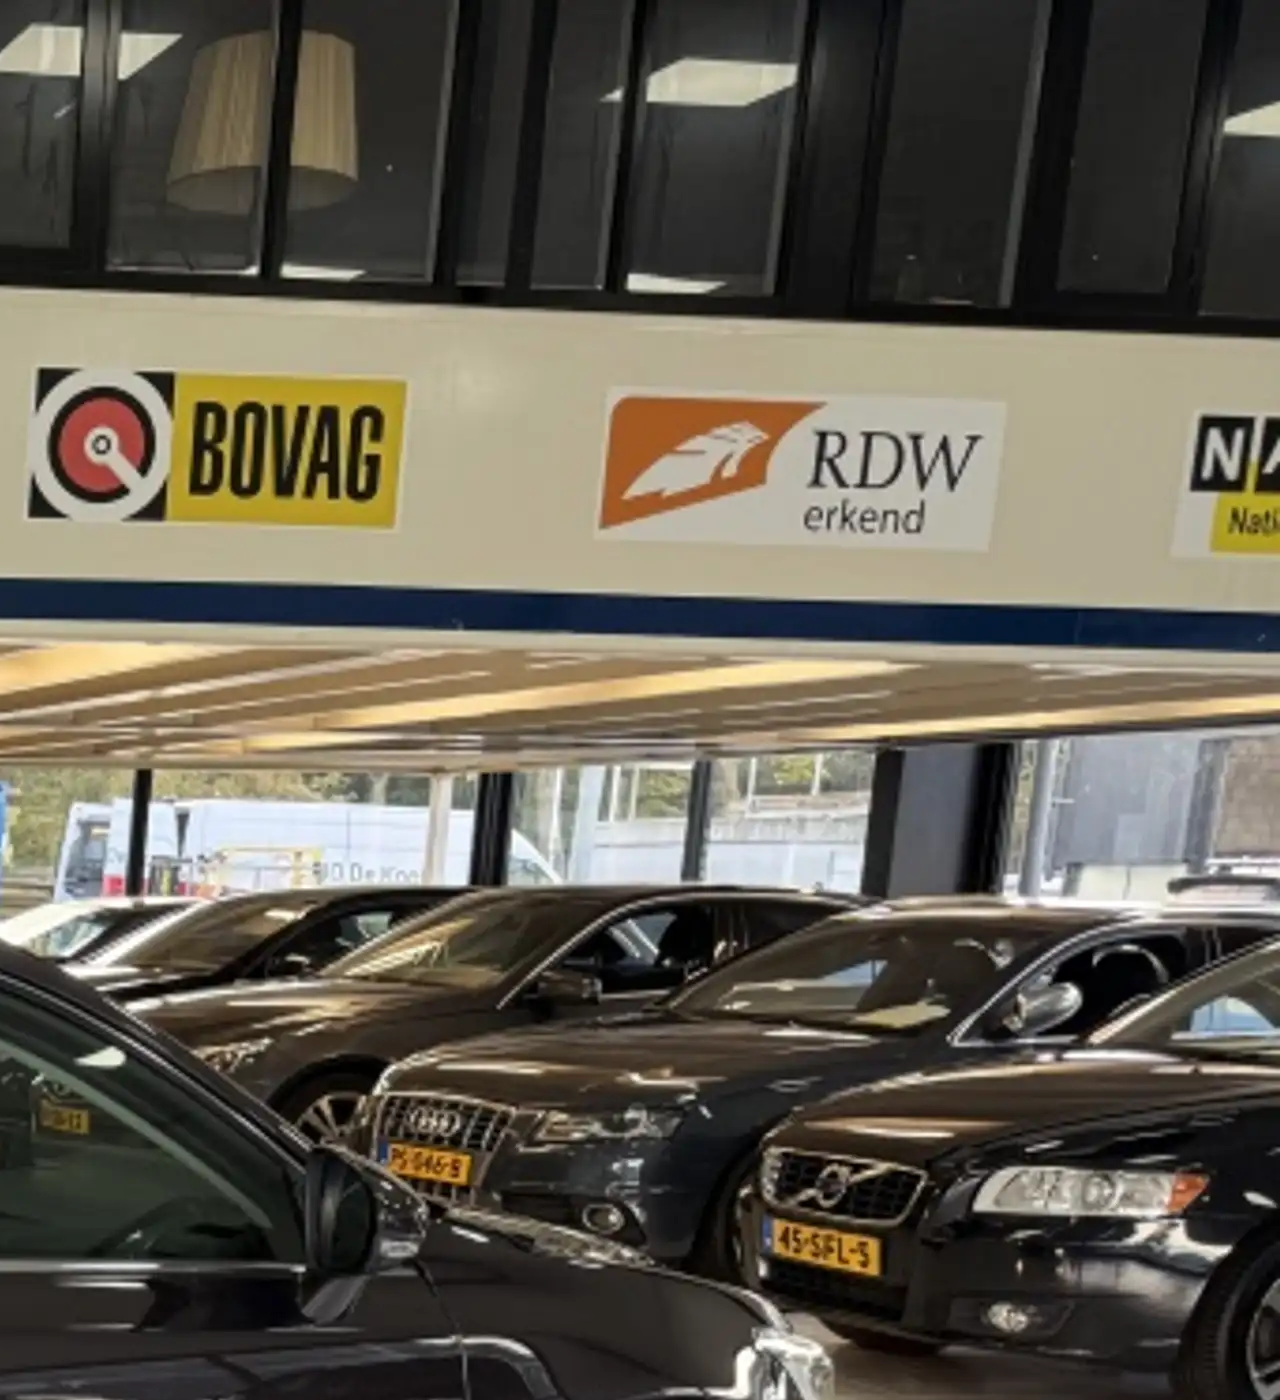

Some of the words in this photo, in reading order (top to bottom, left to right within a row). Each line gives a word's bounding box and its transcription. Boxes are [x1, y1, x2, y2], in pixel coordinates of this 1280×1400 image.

[189, 401, 384, 503] BOVAG
[806, 430, 983, 492] RDW
[803, 498, 926, 534] erkend
[779, 1225, 870, 1269] 45-SFL-5
